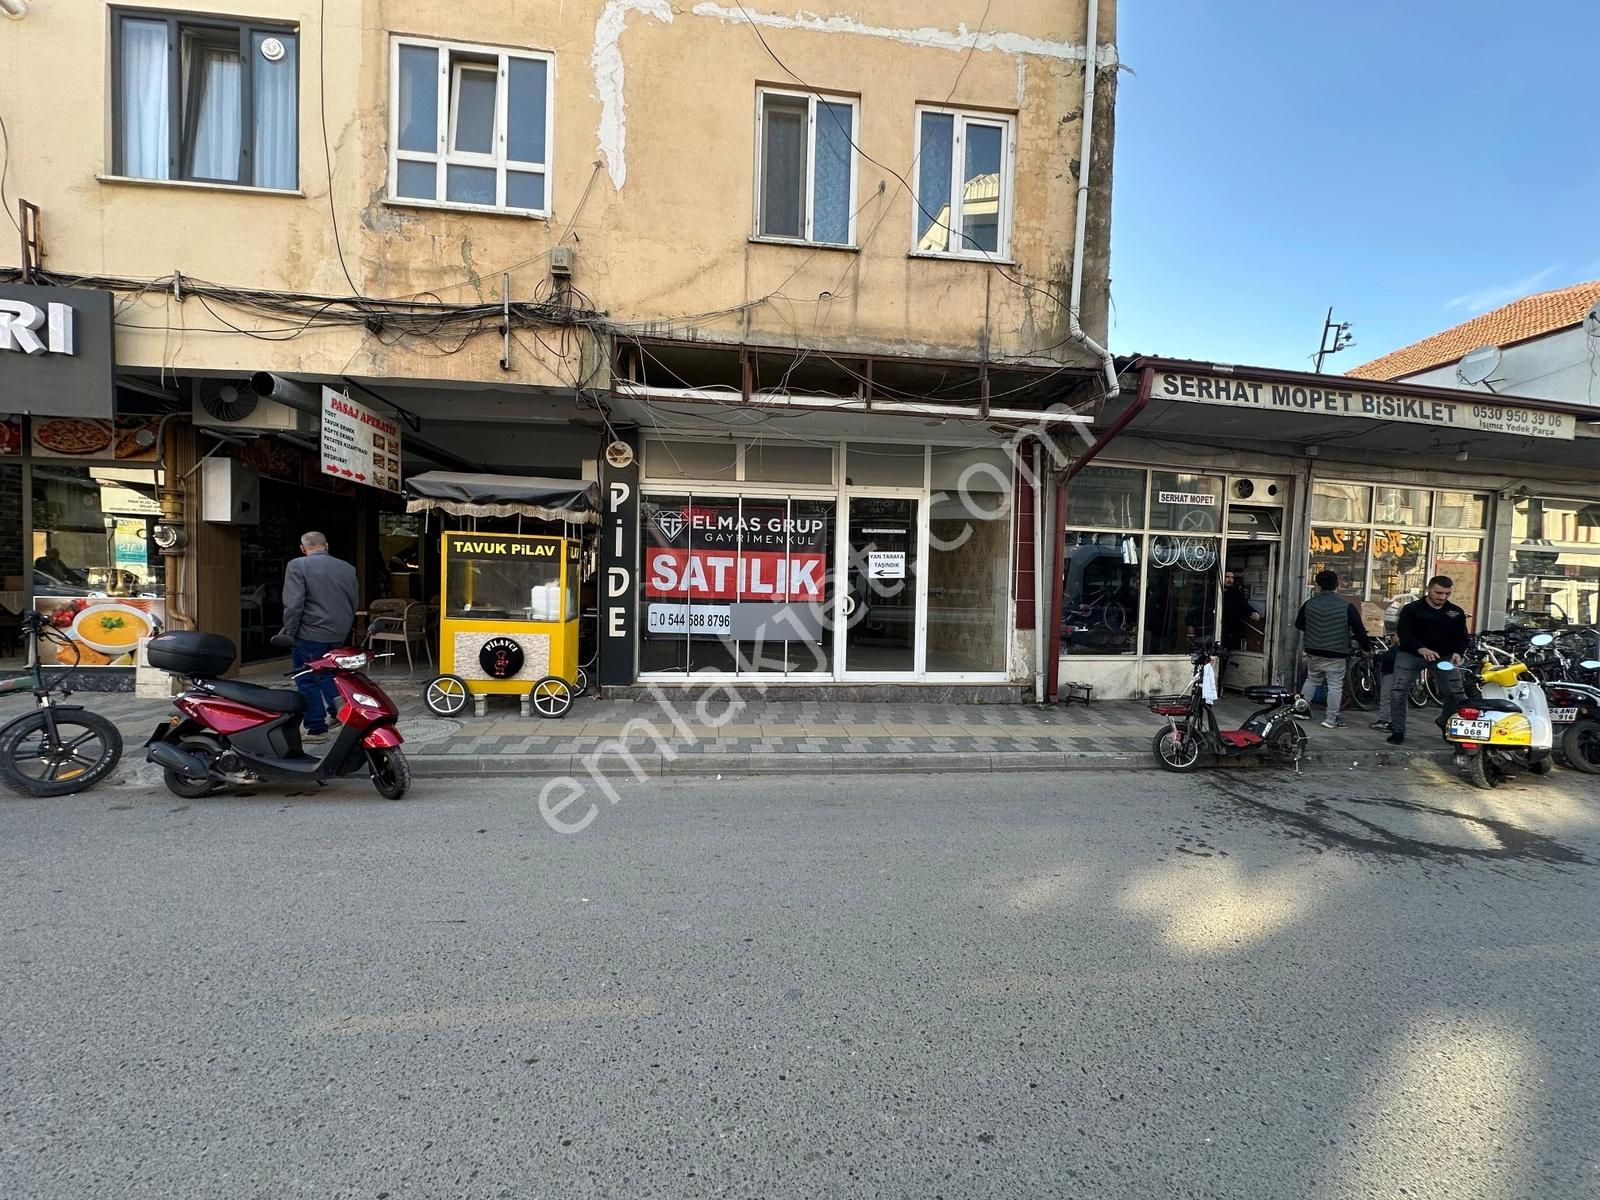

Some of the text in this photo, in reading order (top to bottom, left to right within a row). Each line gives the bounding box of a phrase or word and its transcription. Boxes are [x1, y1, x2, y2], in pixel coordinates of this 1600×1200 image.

[1163, 374, 1262, 404] SERHAT
[1272, 385, 1352, 412] MOPET
[324, 409, 336, 418] TOST
[330, 397, 358, 419] PASAJ
[1473, 405, 1561, 427] 0530 950 39 06
[1506, 423, 1529, 432] Yedek
[1533, 426, 1554, 436] Parça
[1161, 494, 1213, 503] SERHAT MOPET
[692, 516, 823, 533] ELMAS GRUP
[454, 542, 507, 554] TAVUK
[652, 554, 819, 595] SATILIK
[660, 613, 730, 627] 0 544 588 8796
